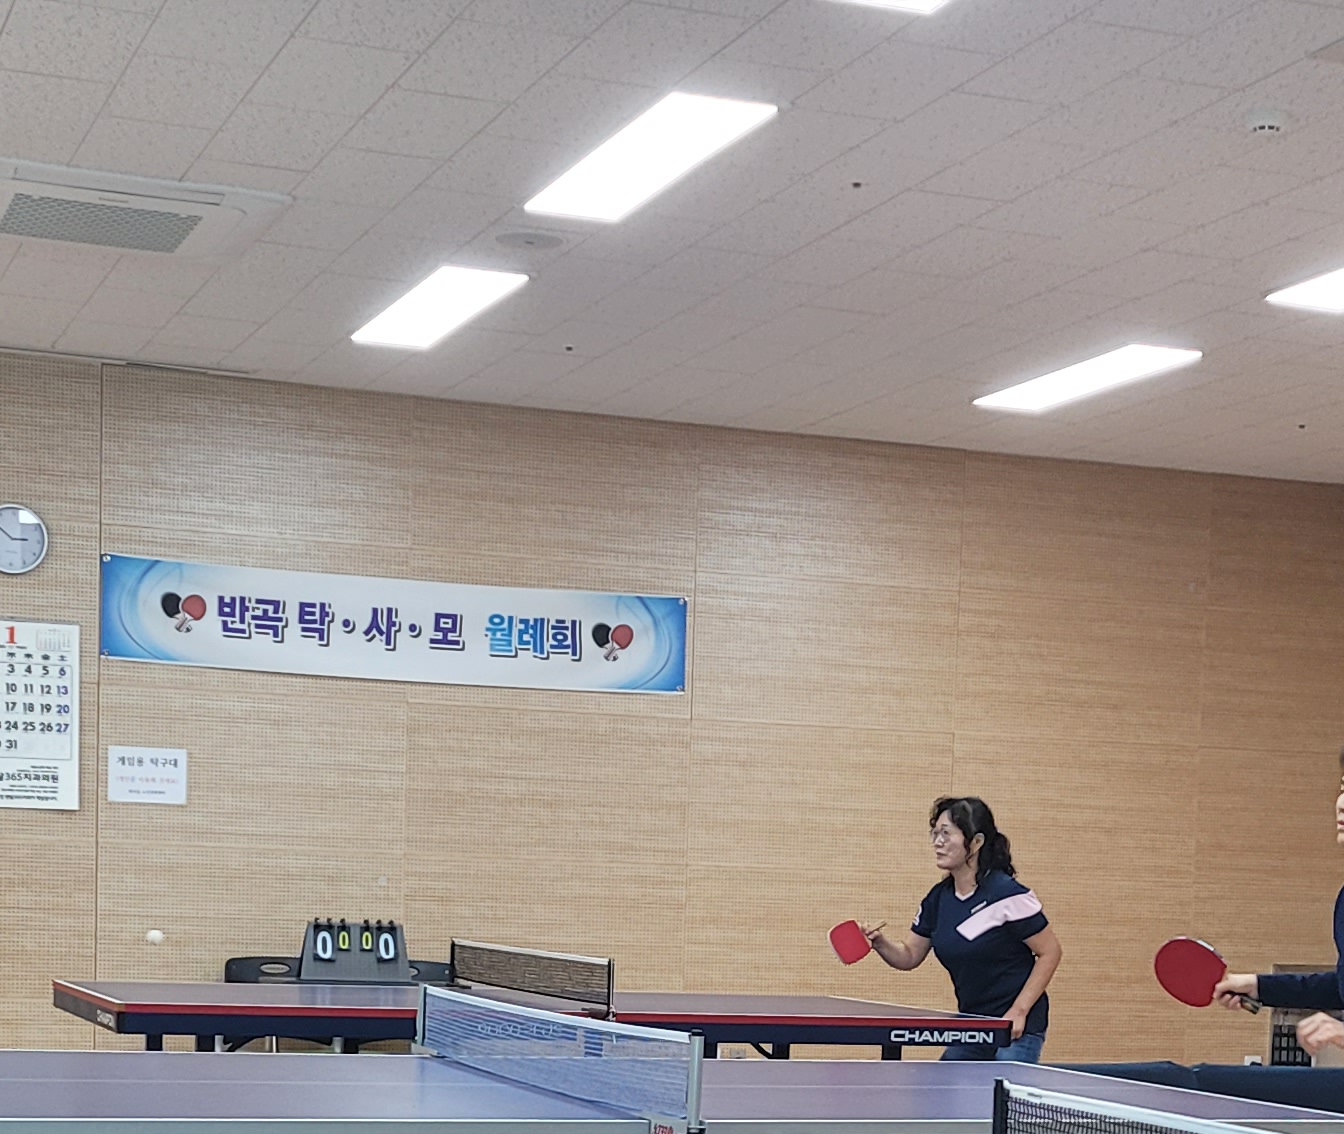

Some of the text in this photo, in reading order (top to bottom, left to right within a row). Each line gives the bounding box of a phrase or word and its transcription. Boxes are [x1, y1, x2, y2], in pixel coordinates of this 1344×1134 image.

[217, 594, 288, 642] 반곡
[485, 612, 582, 661] 월례회
[5, 626, 17, 644] 1
[7, 664, 15, 673] 3
[24, 664, 32, 674] 4
[41, 666, 49, 675] 5
[59, 667, 66, 676] 6
[6, 683, 17, 693] 10
[24, 684, 34, 694] 11
[40, 685, 52, 694] 12
[56, 685, 68, 695] 13
[5, 702, 17, 711] 17
[22, 703, 34, 713] 18
[40, 703, 52, 713] 19
[56, 704, 70, 714] 20
[4, 721, 18, 731] 24
[22, 722, 36, 731] 25
[39, 722, 53, 732] 26
[56, 723, 69, 733] 27
[5, 739, 17, 749] 31
[316, 930, 395, 960] 0 0 0 0
[890, 1030, 994, 1044] CHAMPION
